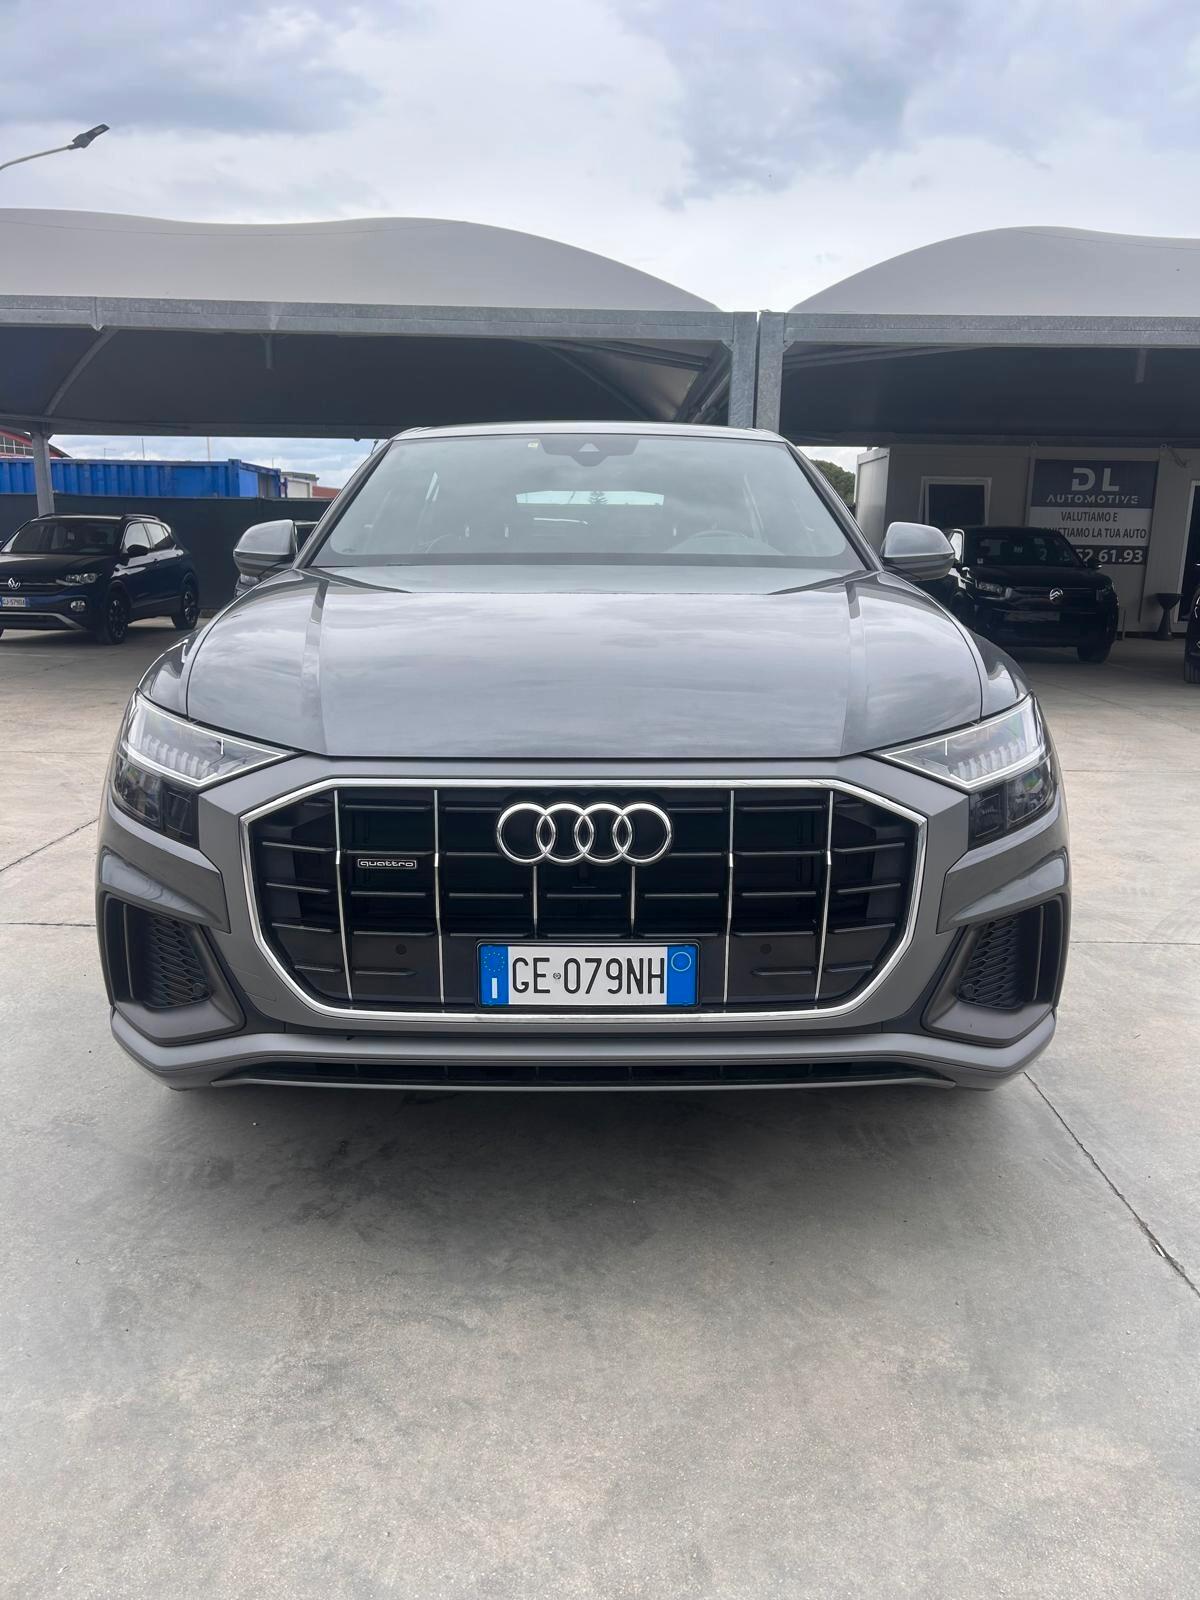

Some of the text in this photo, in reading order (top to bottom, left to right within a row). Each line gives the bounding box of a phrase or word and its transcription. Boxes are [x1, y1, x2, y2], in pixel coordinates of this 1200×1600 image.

[1046, 494, 1140, 504] AUTOMOTIVE
[1061, 511, 1118, 522] VALUTIAMO E
[1050, 527, 1147, 539] TIAMO LA TUA AUTO
[1098, 549, 1143, 563] 61.93
[512, 957, 551, 994] GE
[563, 957, 665, 995] 079NH
